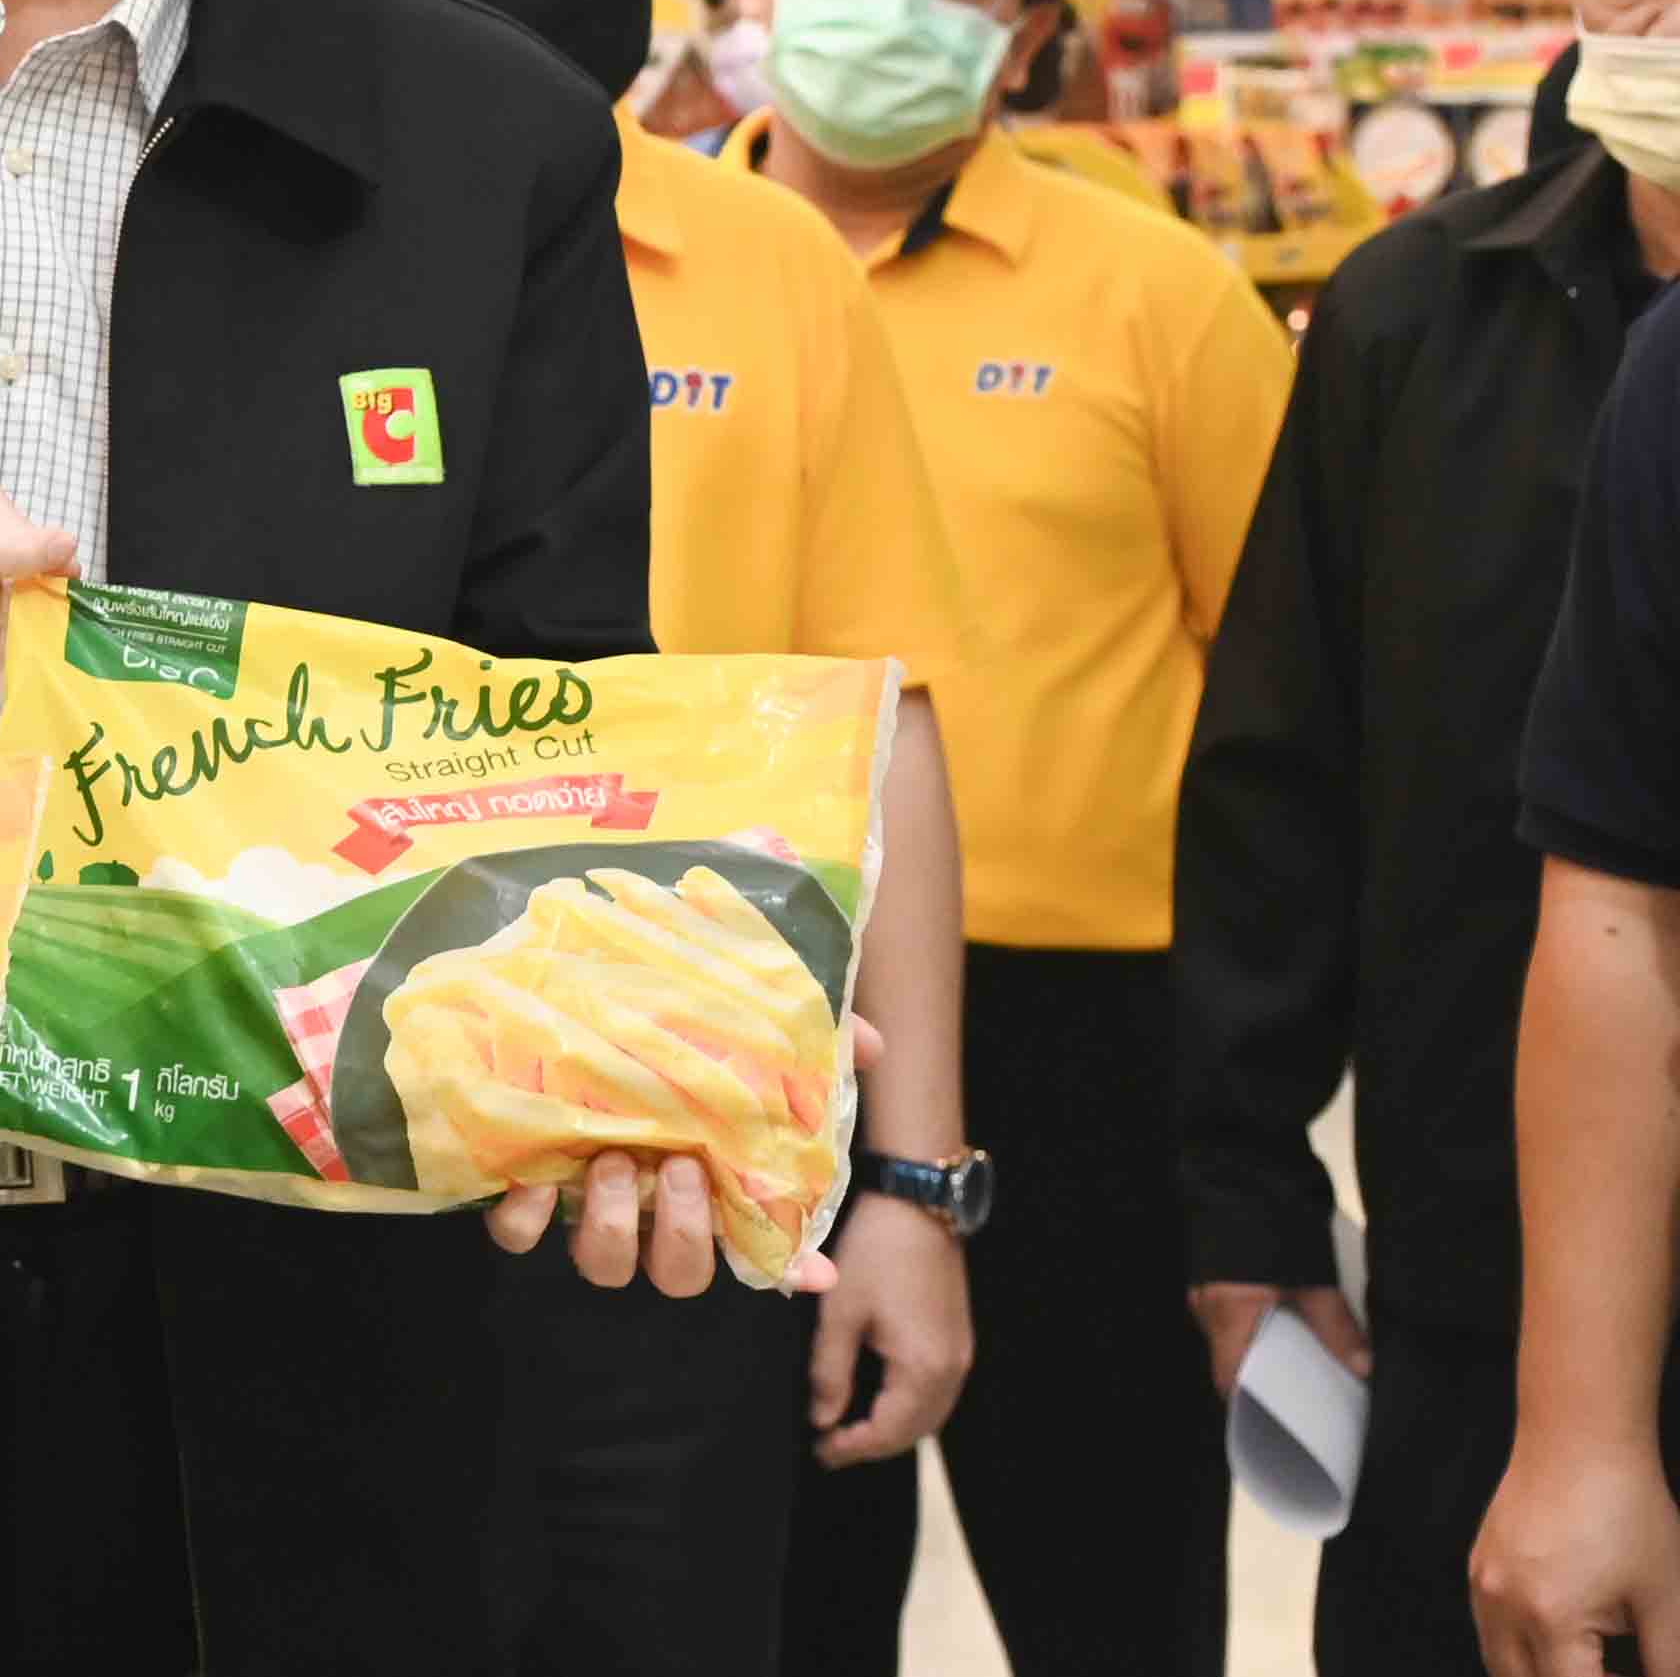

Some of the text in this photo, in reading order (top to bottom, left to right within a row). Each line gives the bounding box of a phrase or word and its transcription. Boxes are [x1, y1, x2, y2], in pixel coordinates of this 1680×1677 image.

[63, 646, 594, 847] French Fries
[384, 728, 597, 784] Straight Cut
[31, 1075, 112, 1109] WEIGHT
[121, 1068, 142, 1113] 1
[156, 1063, 241, 1101] กิโลกรัม
[154, 1098, 176, 1123] kg
